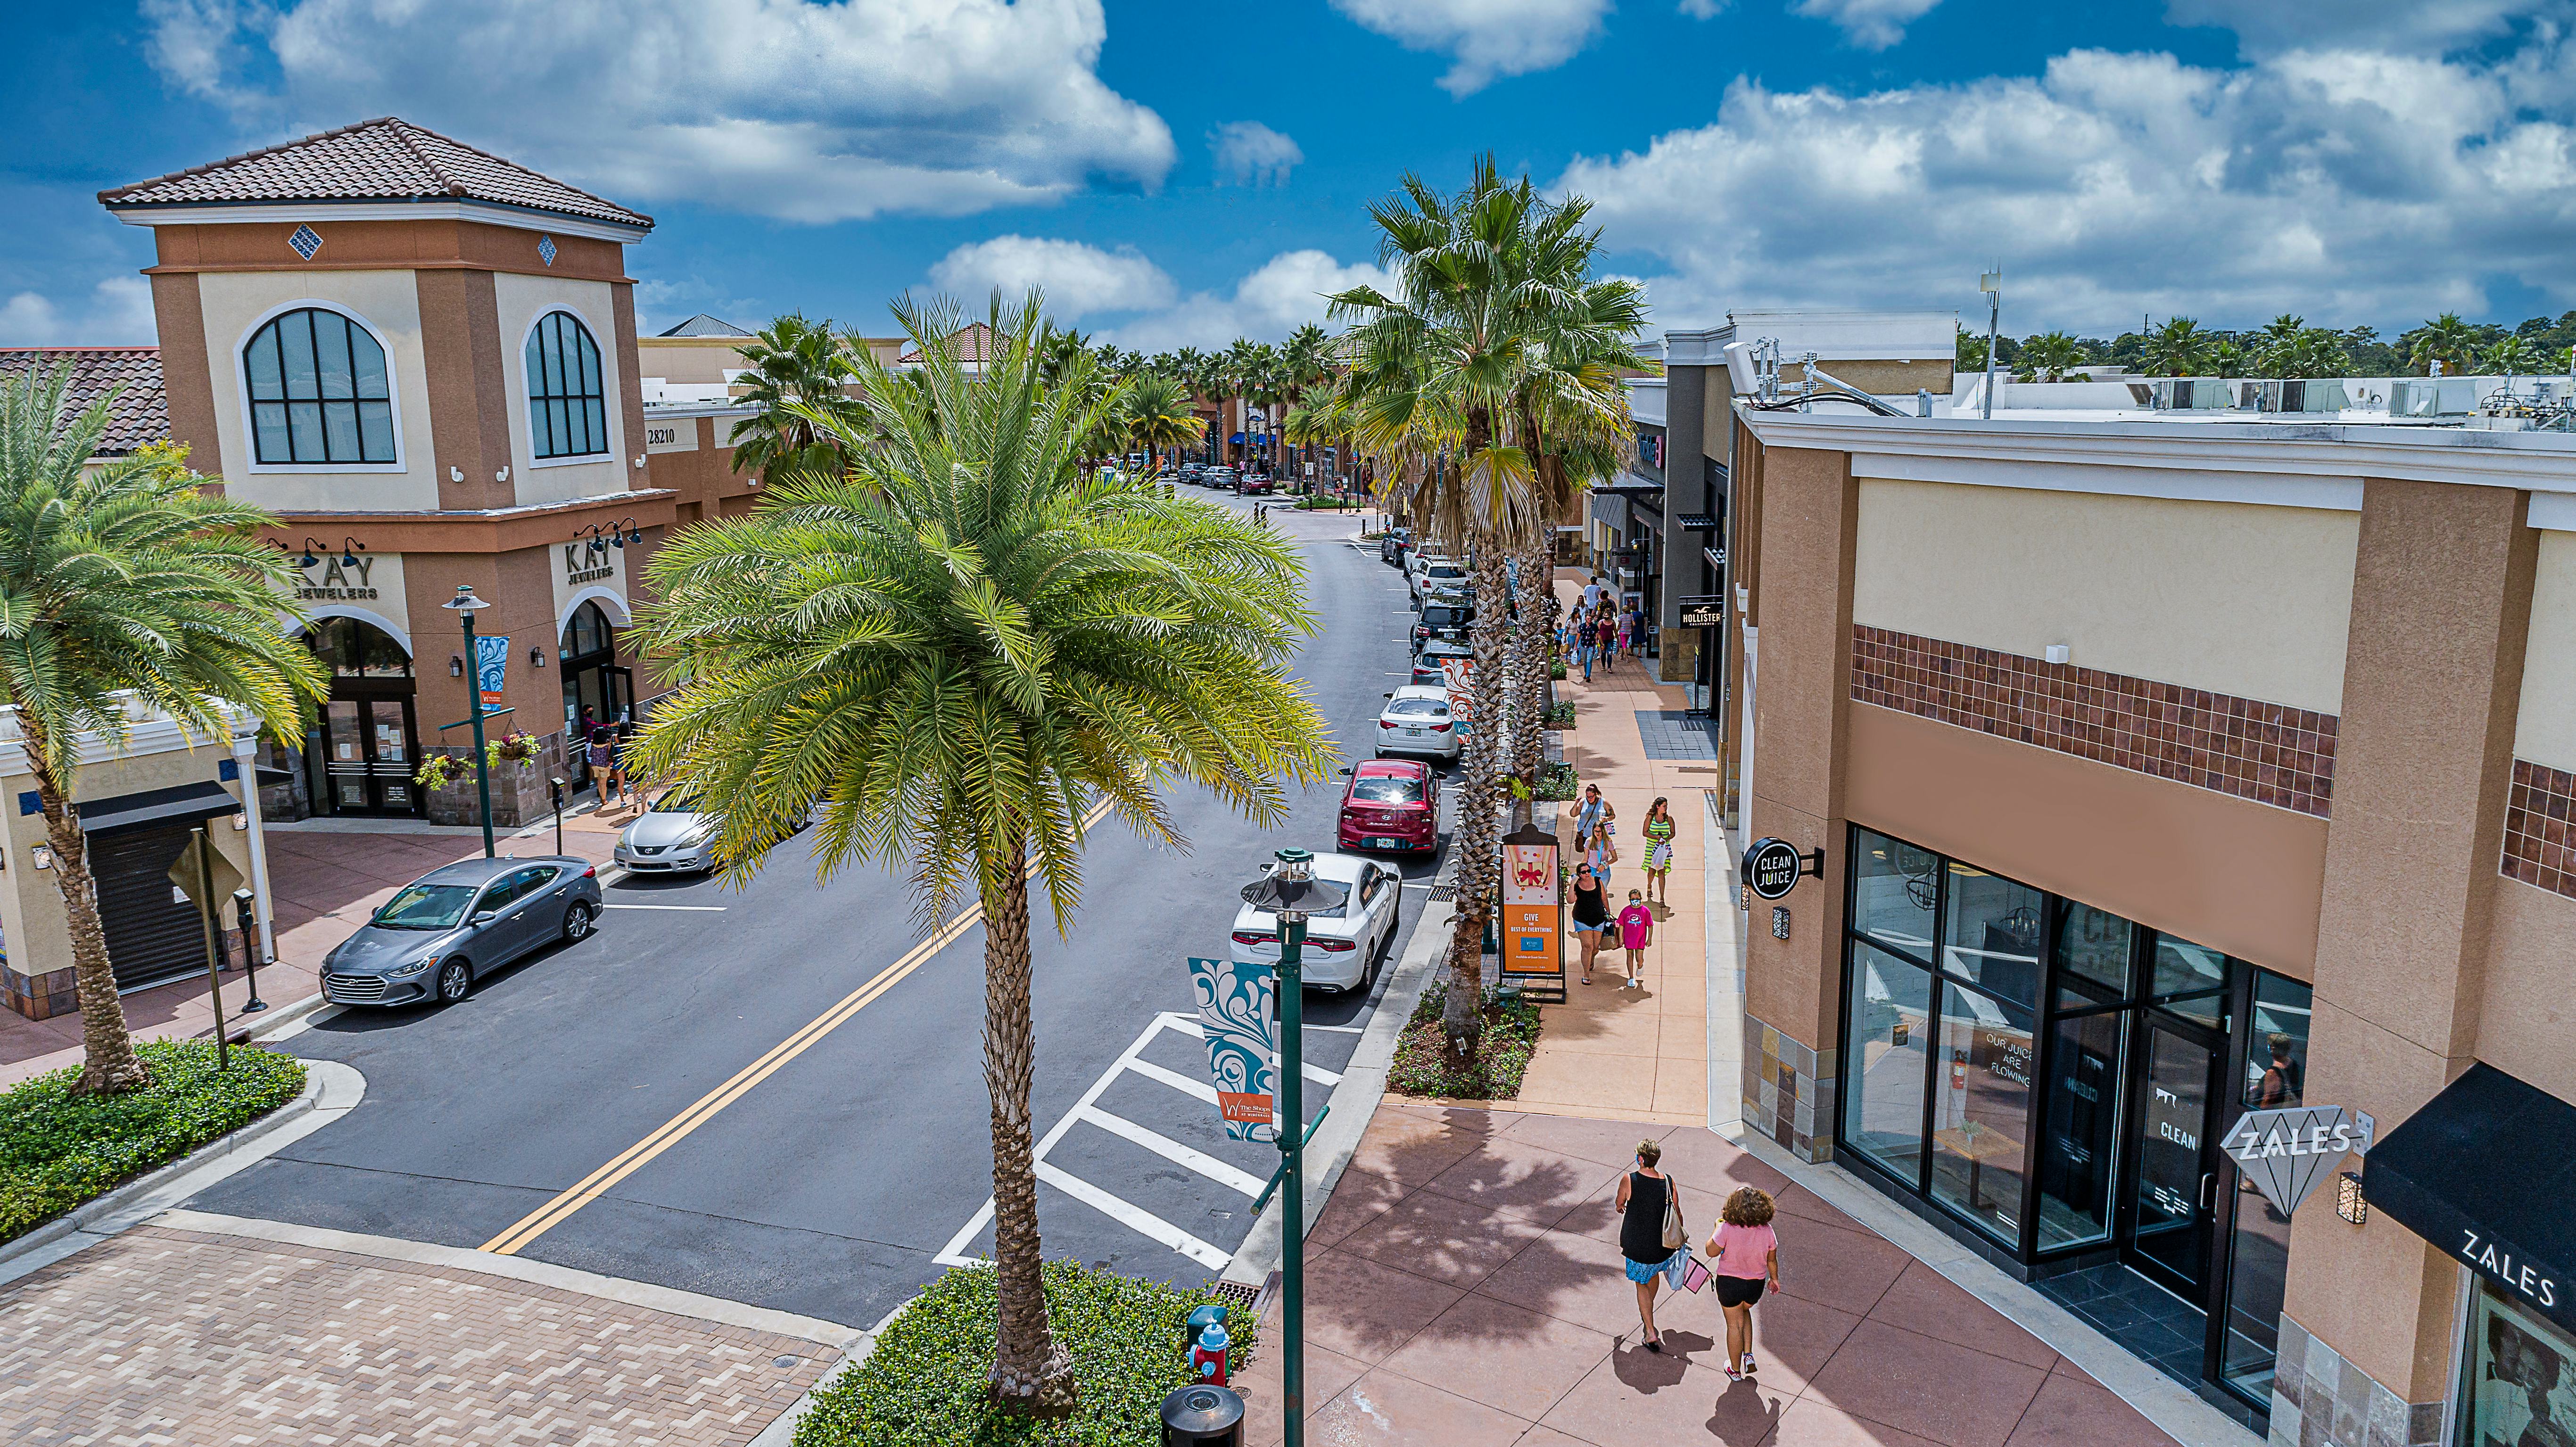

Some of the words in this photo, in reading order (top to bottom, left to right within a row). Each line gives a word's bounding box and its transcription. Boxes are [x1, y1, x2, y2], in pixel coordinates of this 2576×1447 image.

[648, 428, 675, 444] 28210
[565, 539, 611, 573] KAY
[569, 566, 613, 585] JEWELERS
[1683, 613, 1720, 623] HOLLISTER
[1761, 855, 1791, 870] CLEAN
[1759, 871, 1790, 886] JUICE
[1524, 913, 1539, 921] GIVE
[1987, 1034, 2006, 1049] OUR
[2003, 1054, 2022, 1069] ARE
[1991, 1062, 2030, 1087] FLOWING
[2161, 1122, 2196, 1151] CLEAN
[2239, 1124, 2350, 1160] ZALES
[2462, 1229, 2554, 1307] ZALES
